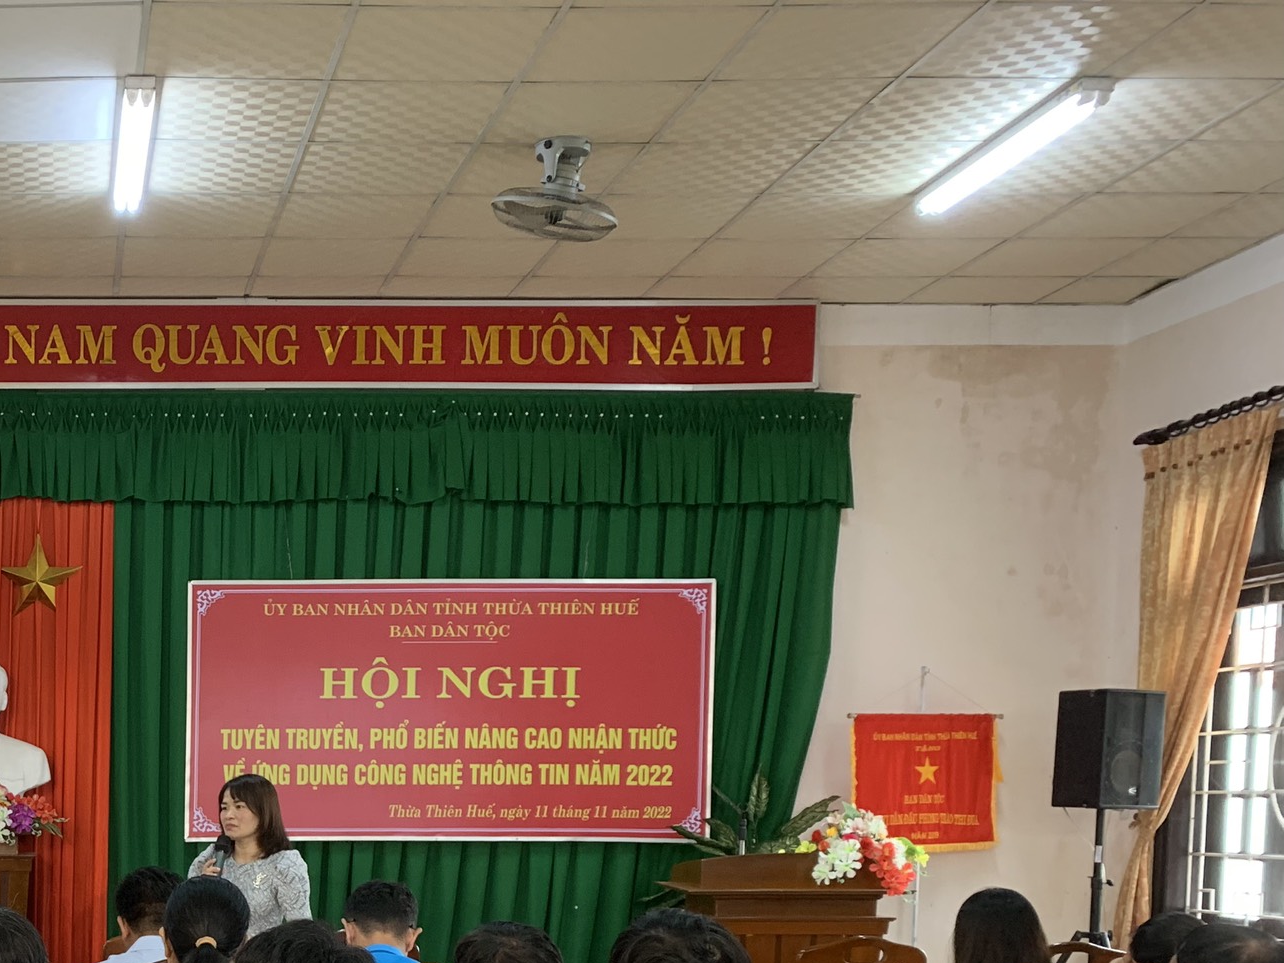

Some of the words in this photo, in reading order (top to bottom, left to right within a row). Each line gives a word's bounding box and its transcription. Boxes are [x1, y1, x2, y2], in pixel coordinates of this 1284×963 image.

[5, 325, 117, 365] NAM
[133, 324, 299, 373] QUANG
[316, 326, 445, 365] VINH
[462, 313, 612, 365] MUÔN
[628, 314, 745, 366] NĂM
[762, 327, 773, 366] !
[263, 598, 288, 616] ỦY
[292, 603, 329, 616] BAN
[334, 600, 385, 616] NHÂN
[390, 599, 429, 616] DÂN
[433, 598, 478, 615] TỈNH
[483, 598, 534, 615] THỪA
[538, 598, 595, 615] THIÊN
[601, 597, 640, 615] HUẾ
[389, 625, 427, 638] BAN
[432, 622, 469, 638] DÂN
[474, 622, 511, 642] TỘC
[319, 656, 422, 709] HỘI
[436, 666, 581, 708] NGHỊ
[220, 724, 280, 751] TUYÊN
[286, 721, 364, 752] TRUYỀN,
[369, 718, 408, 750] PHỔ
[413, 720, 459, 750] BIẾN
[464, 723, 519, 750] NÂNG
[524, 727, 563, 750] CAO
[568, 723, 623, 754] NHẬN
[628, 723, 677, 750] THỨC
[296, 763, 349, 791] DỤNG
[354, 759, 407, 786] CÔNG
[412, 759, 464, 790] NGHỆ
[469, 759, 533, 786] THÔNG
[538, 763, 570, 785] TIN
[575, 760, 621, 786] NĂM
[625, 764, 673, 786] 2022
[388, 804, 422, 819] Thừa
[425, 804, 463, 818] Thiên
[466, 802, 496, 820] Huế,
[499, 805, 532, 821] ngày
[534, 805, 549, 818] 11
[552, 804, 589, 821] tháng
[593, 805, 608, 818] 11
[611, 806, 640, 819] năm
[642, 805, 673, 819] 2022
